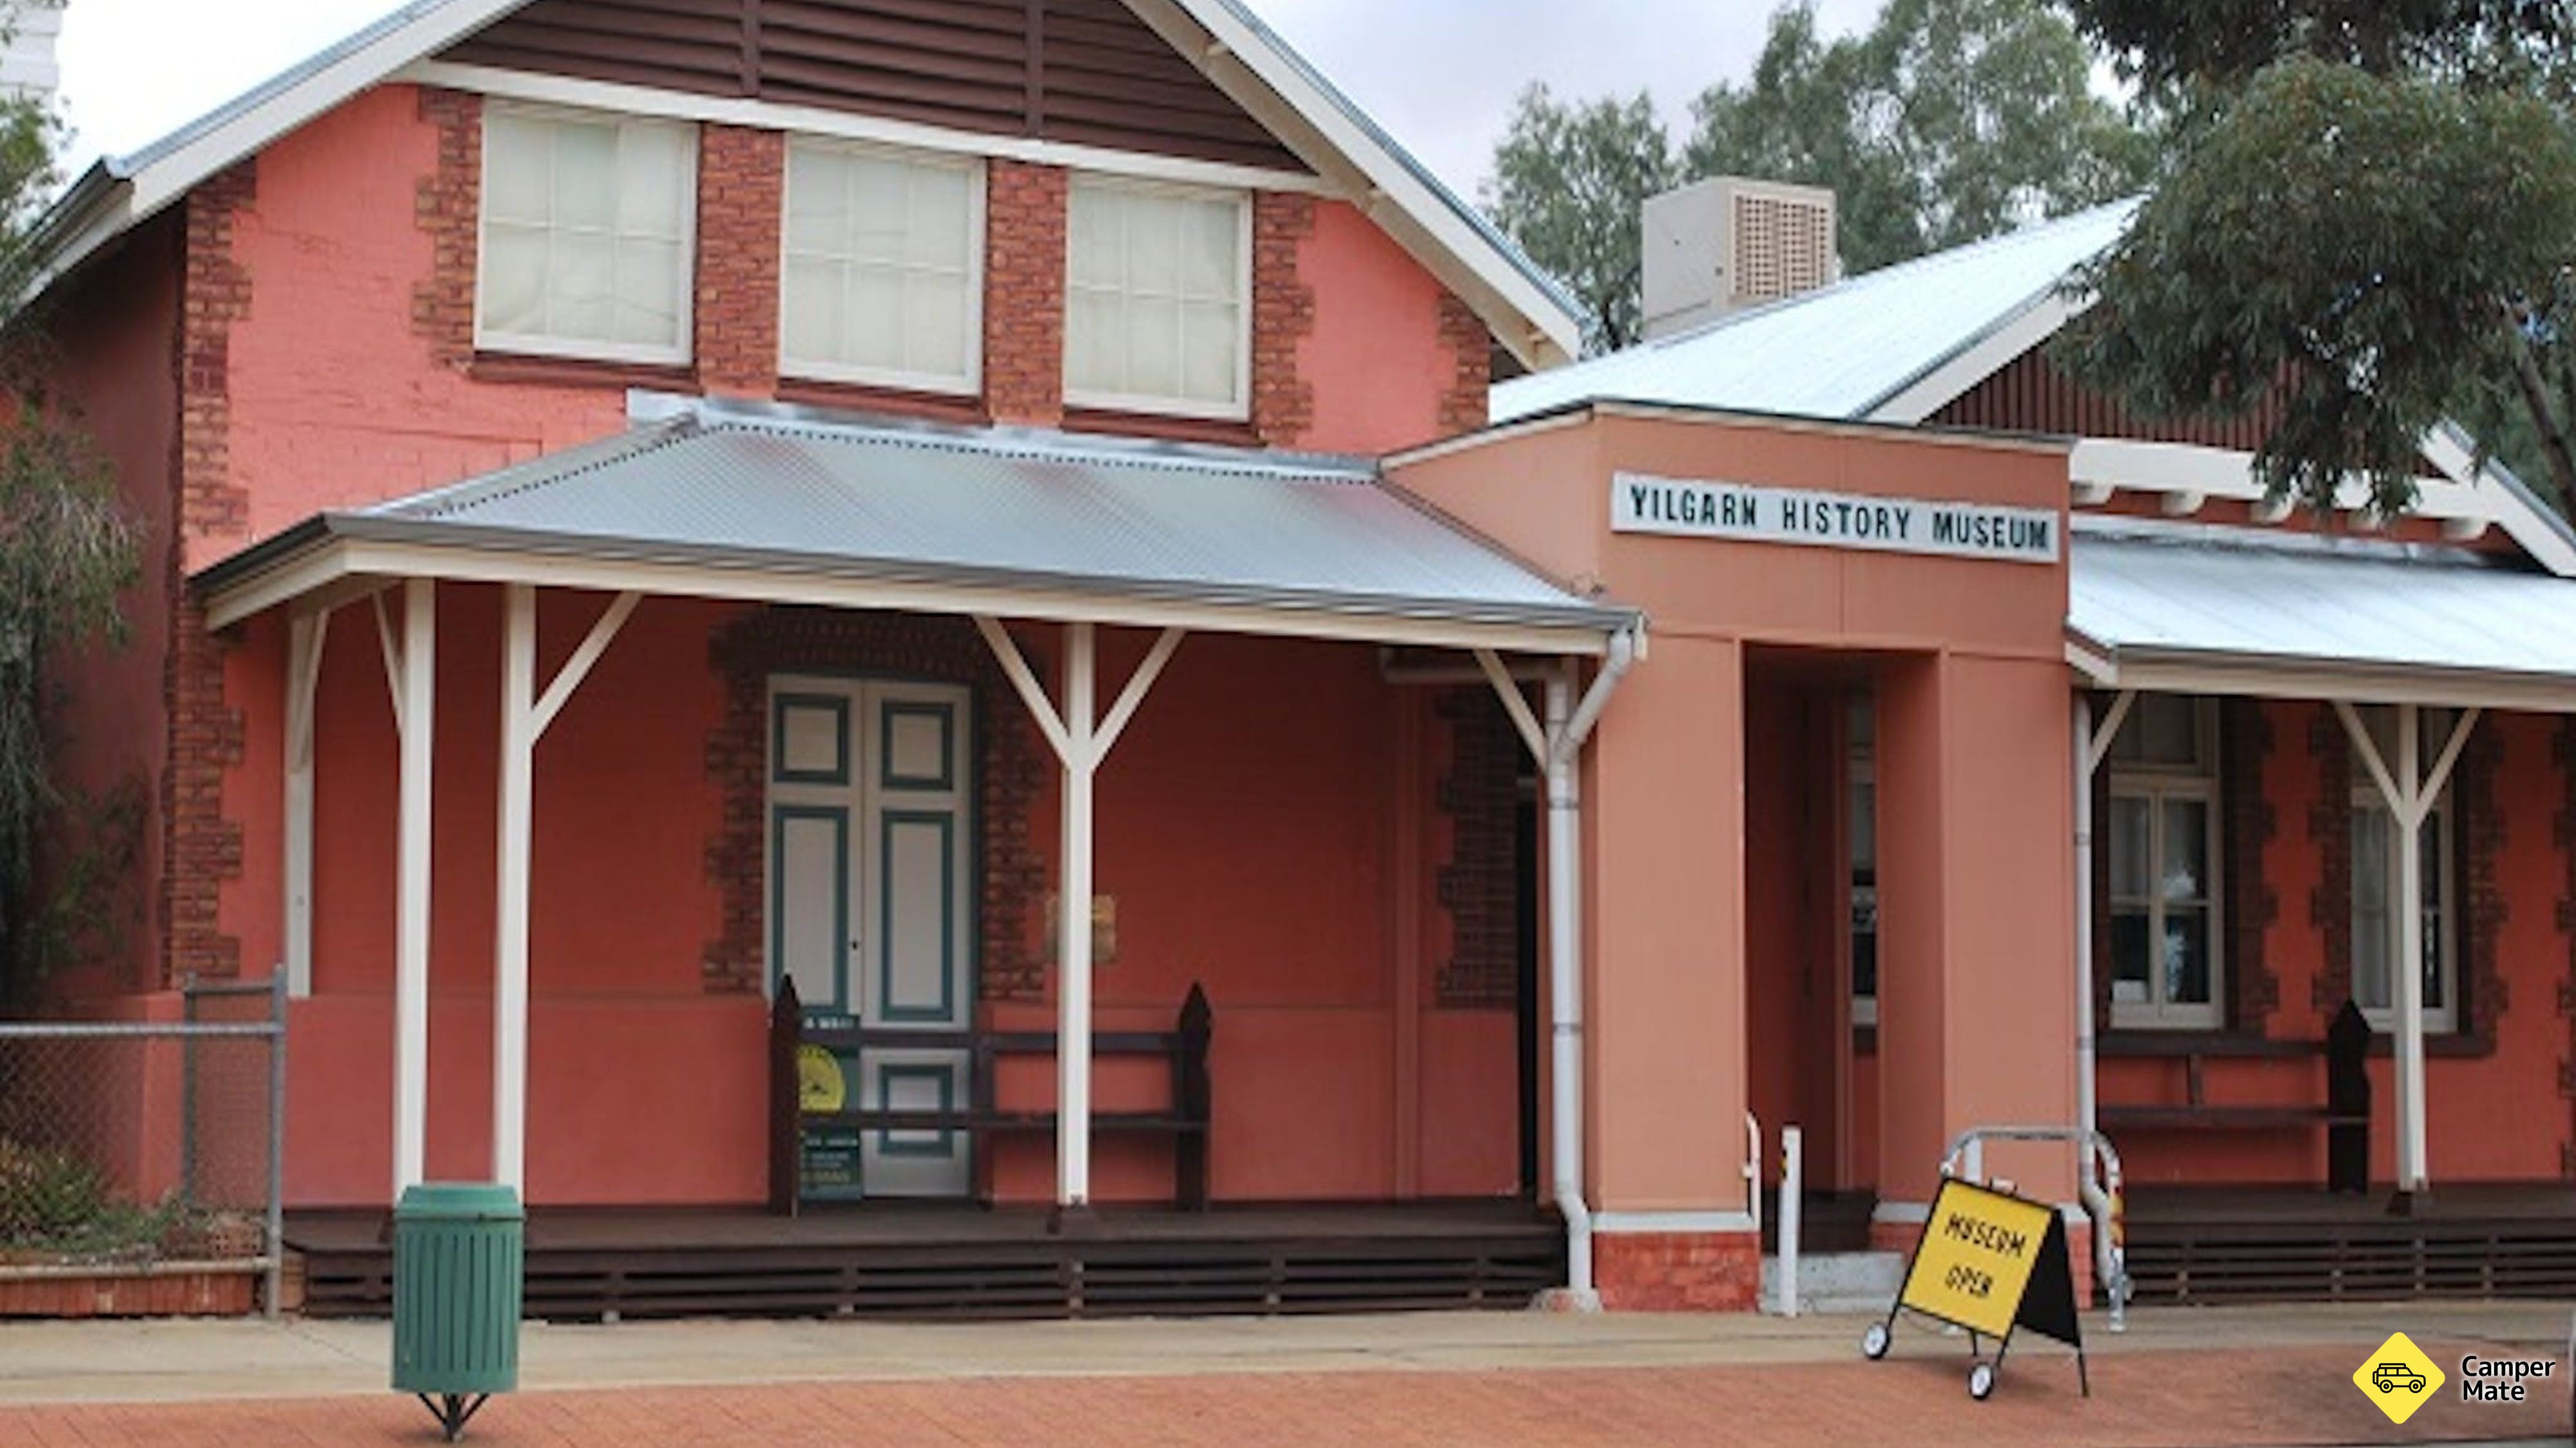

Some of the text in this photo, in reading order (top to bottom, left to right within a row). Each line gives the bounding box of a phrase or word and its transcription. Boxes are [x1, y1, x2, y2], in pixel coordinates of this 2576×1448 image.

[1631, 485, 2049, 550] YILGARN HISTORY MUSEUM
[1945, 1213, 2026, 1257] MUSEUM
[1946, 1264, 1993, 1297] OPEN
